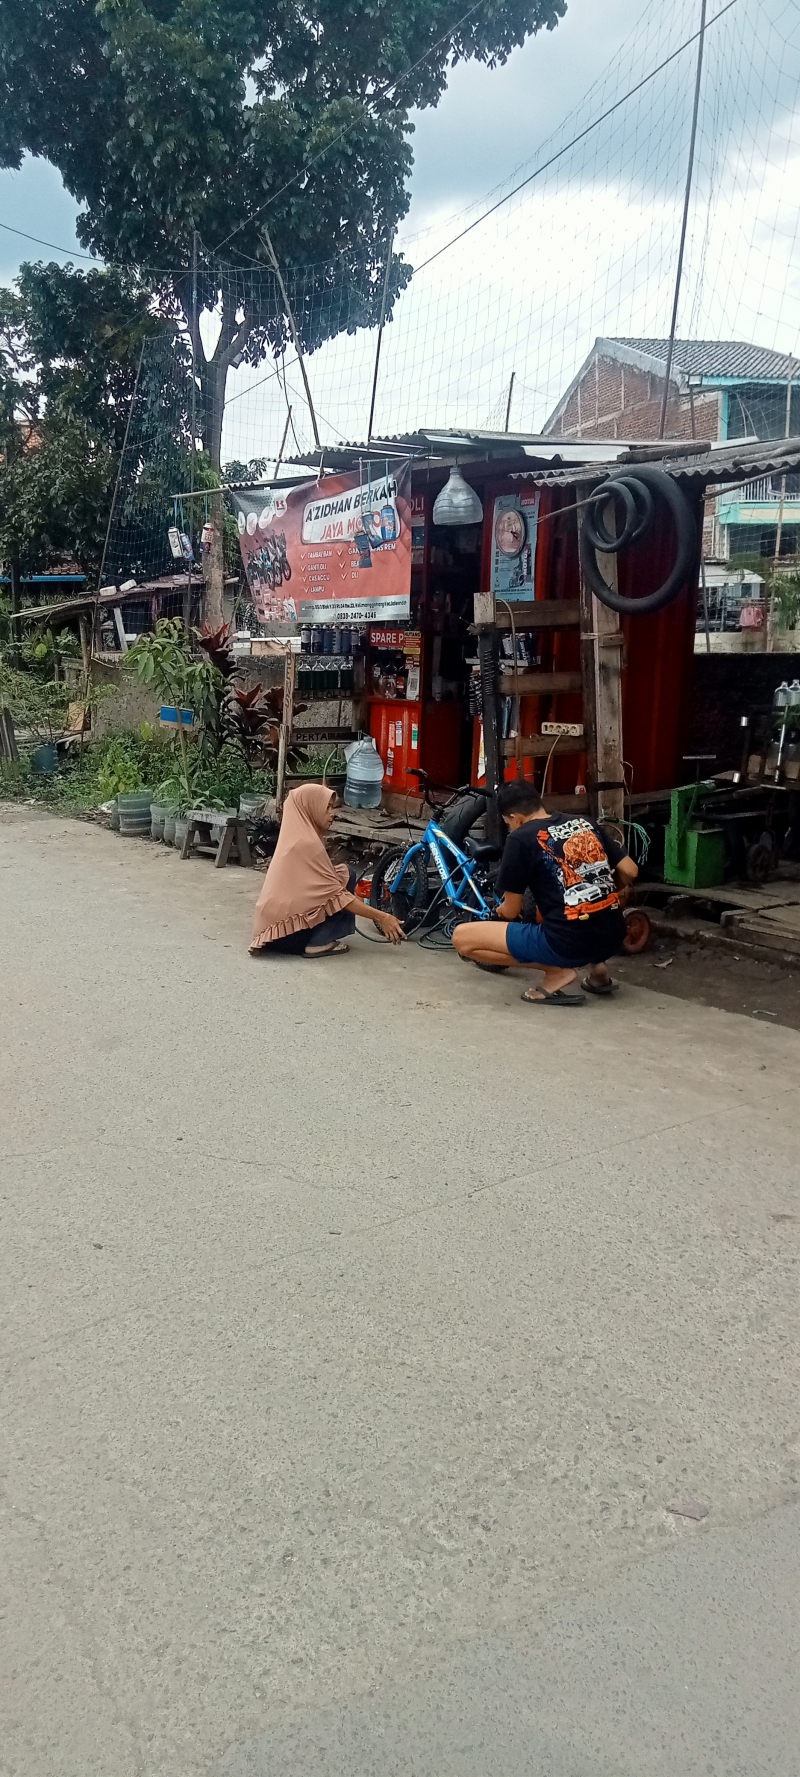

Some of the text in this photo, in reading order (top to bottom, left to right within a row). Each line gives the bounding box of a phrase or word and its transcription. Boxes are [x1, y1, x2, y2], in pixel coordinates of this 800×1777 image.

[305, 480, 398, 523] A'ZIDHAN BERKAH
[319, 521, 344, 541] JAYA
[347, 510, 382, 536] MOO
[371, 632, 397, 643] SPARE
[429, 842, 448, 880] SENATOR
